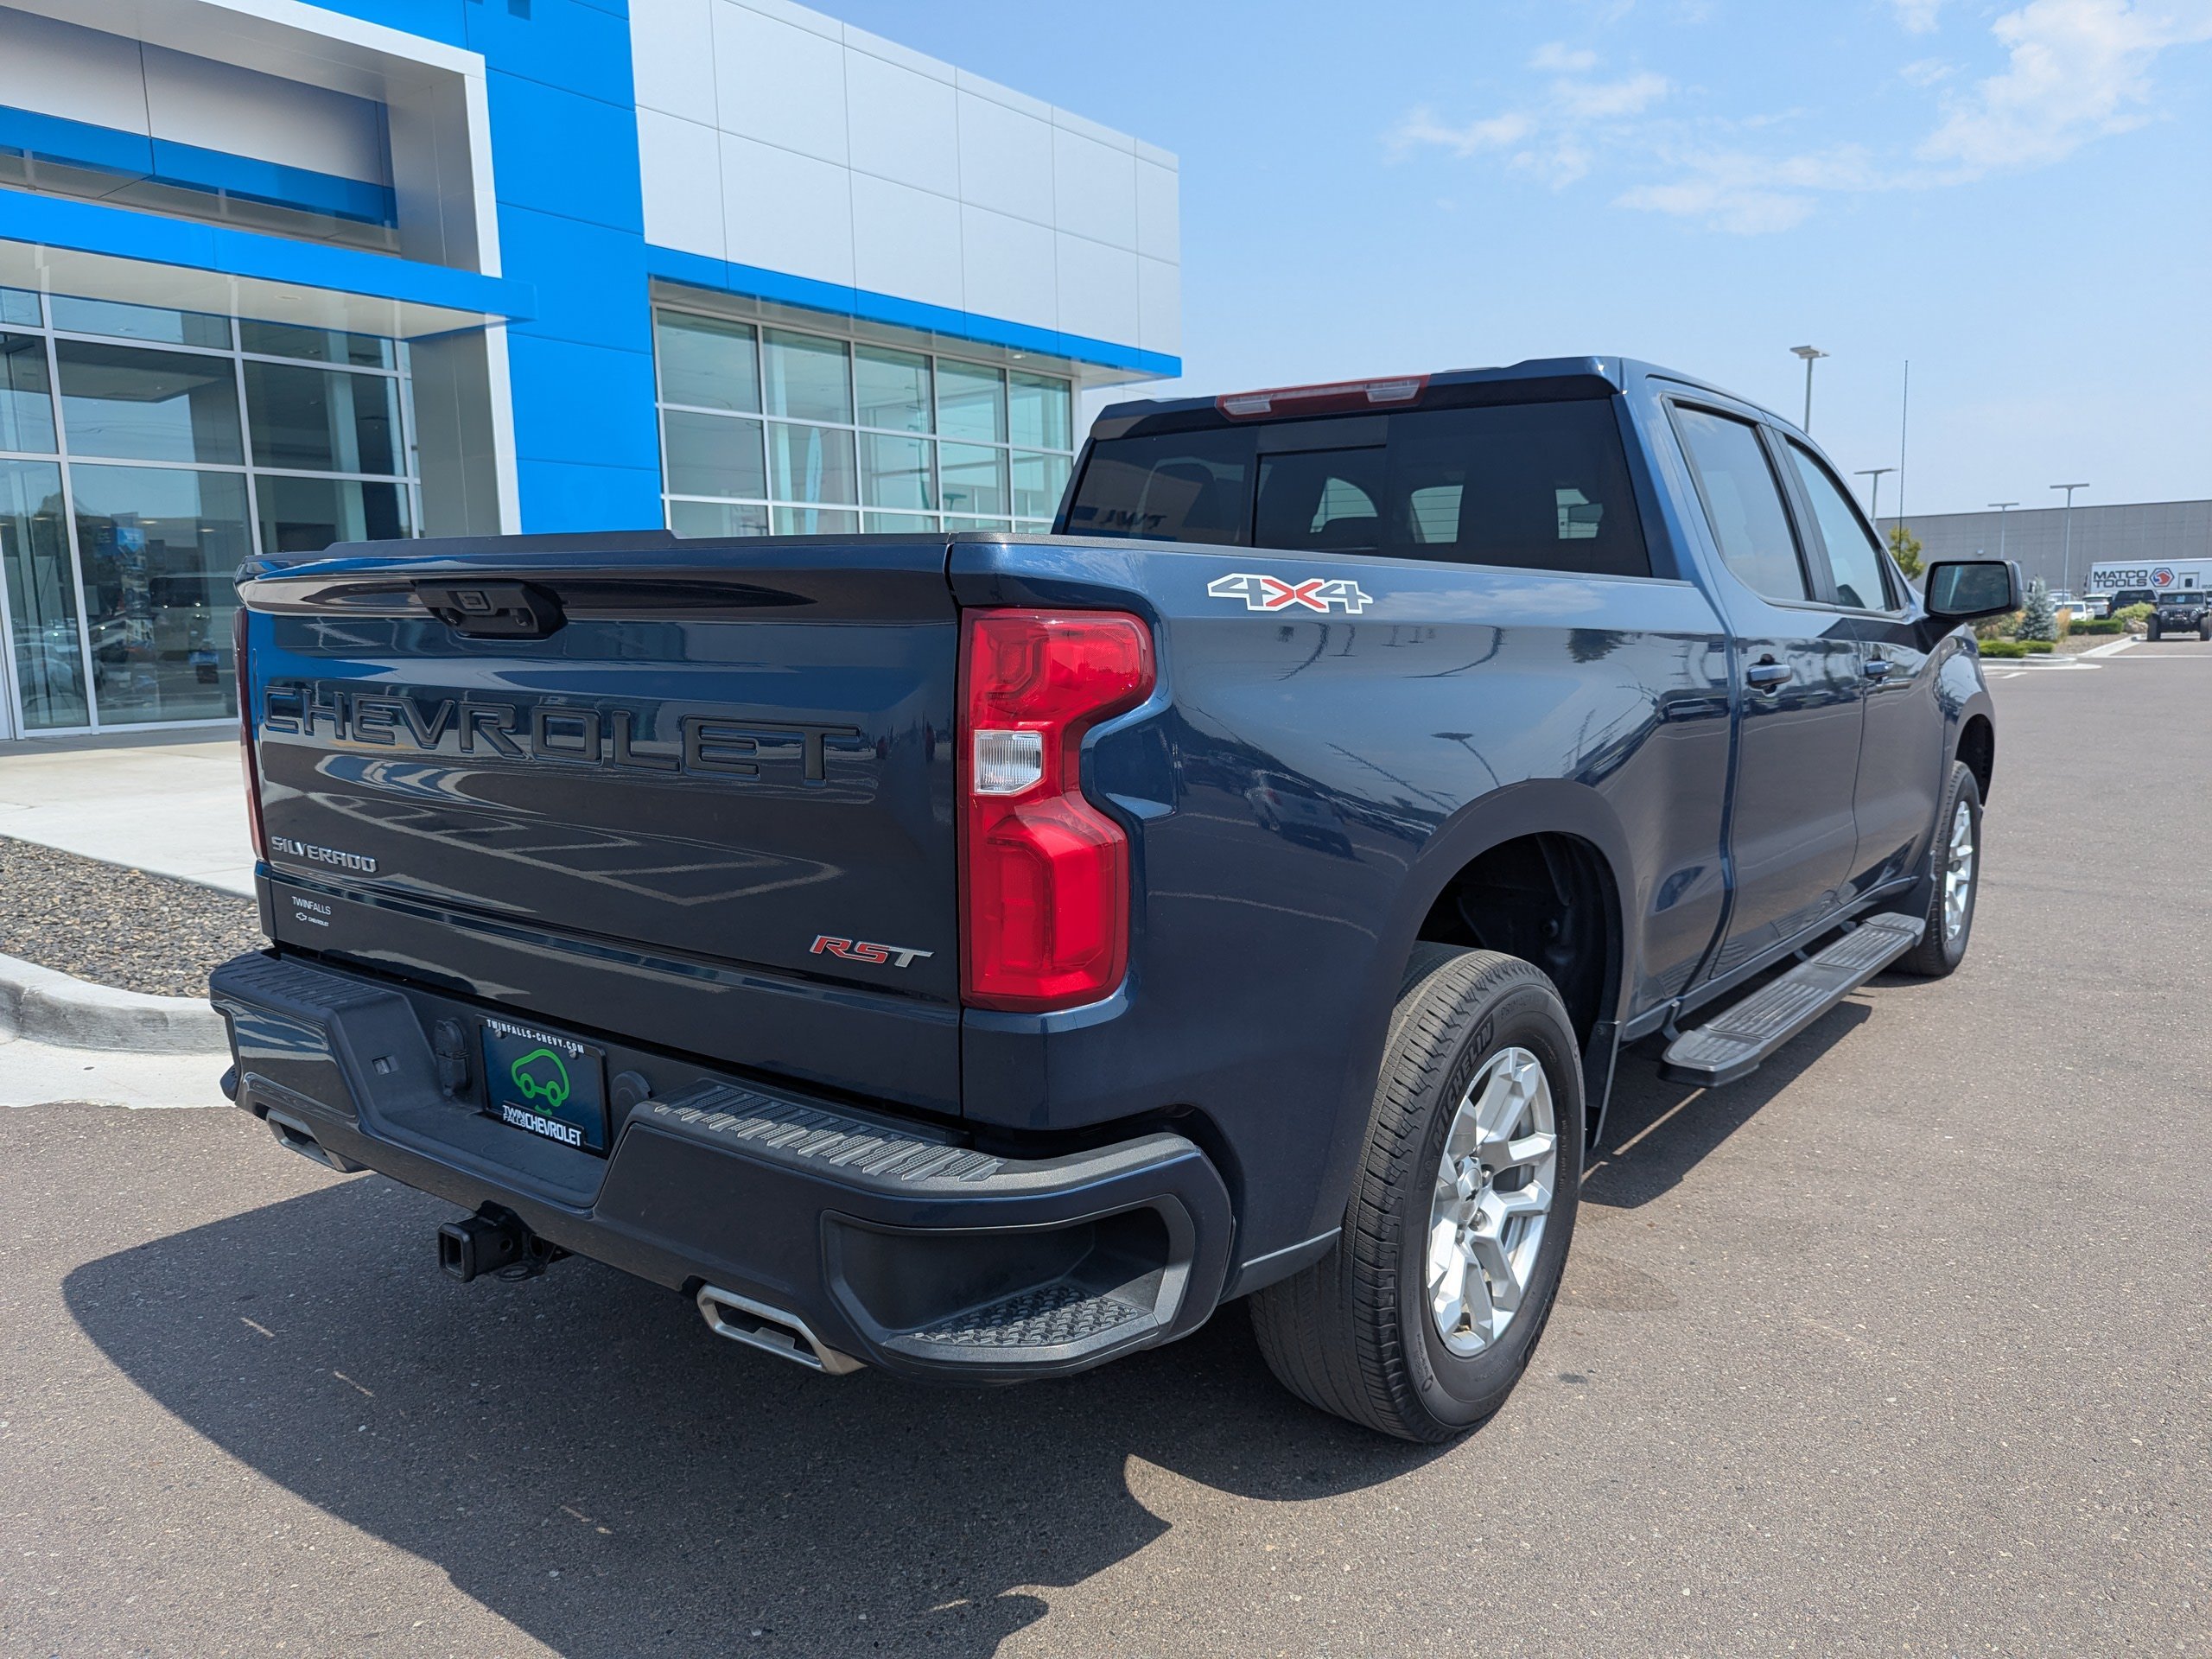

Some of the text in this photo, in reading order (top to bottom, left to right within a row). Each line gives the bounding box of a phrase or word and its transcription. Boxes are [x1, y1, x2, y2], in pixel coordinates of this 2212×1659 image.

[2092, 578, 2147, 588] TOOLS
[2093, 570, 2148, 579] MATCO
[263, 685, 862, 786] CHEVROLET
[271, 836, 378, 873] SILVERADO
[809, 934, 935, 968] RST
[486, 1019, 585, 1054] TWINFALLS-CHEVY.COM
[1432, 1020, 1493, 1150] MICHELIN
[502, 1104, 526, 1120] TWIN
[503, 1112, 526, 1128] FALLS
[524, 1112, 582, 1147] CHEVROLET
